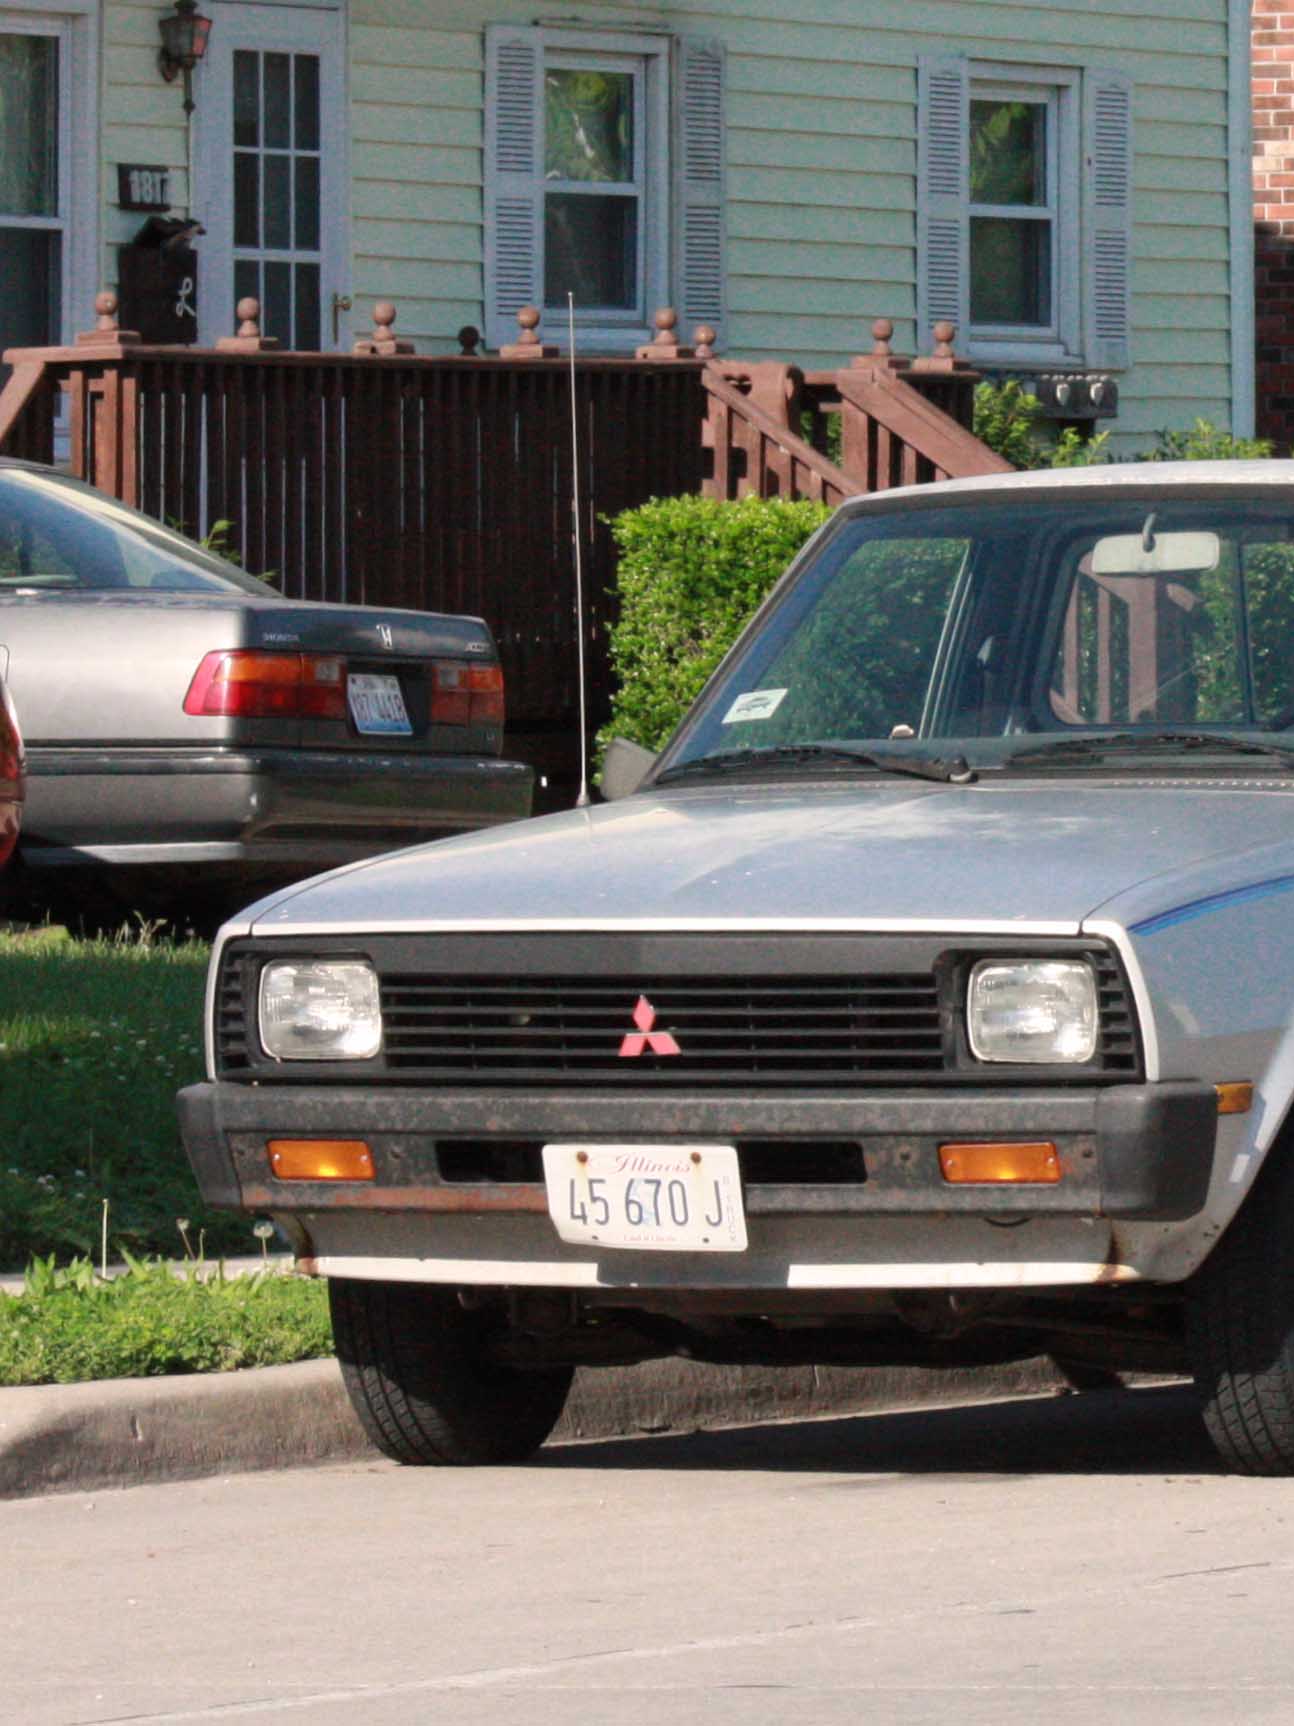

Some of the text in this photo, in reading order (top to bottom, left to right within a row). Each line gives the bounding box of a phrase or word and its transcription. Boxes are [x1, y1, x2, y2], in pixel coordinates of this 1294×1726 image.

[608, 1152, 690, 1174] Illinois
[570, 1178, 723, 1227] 45 670 J
